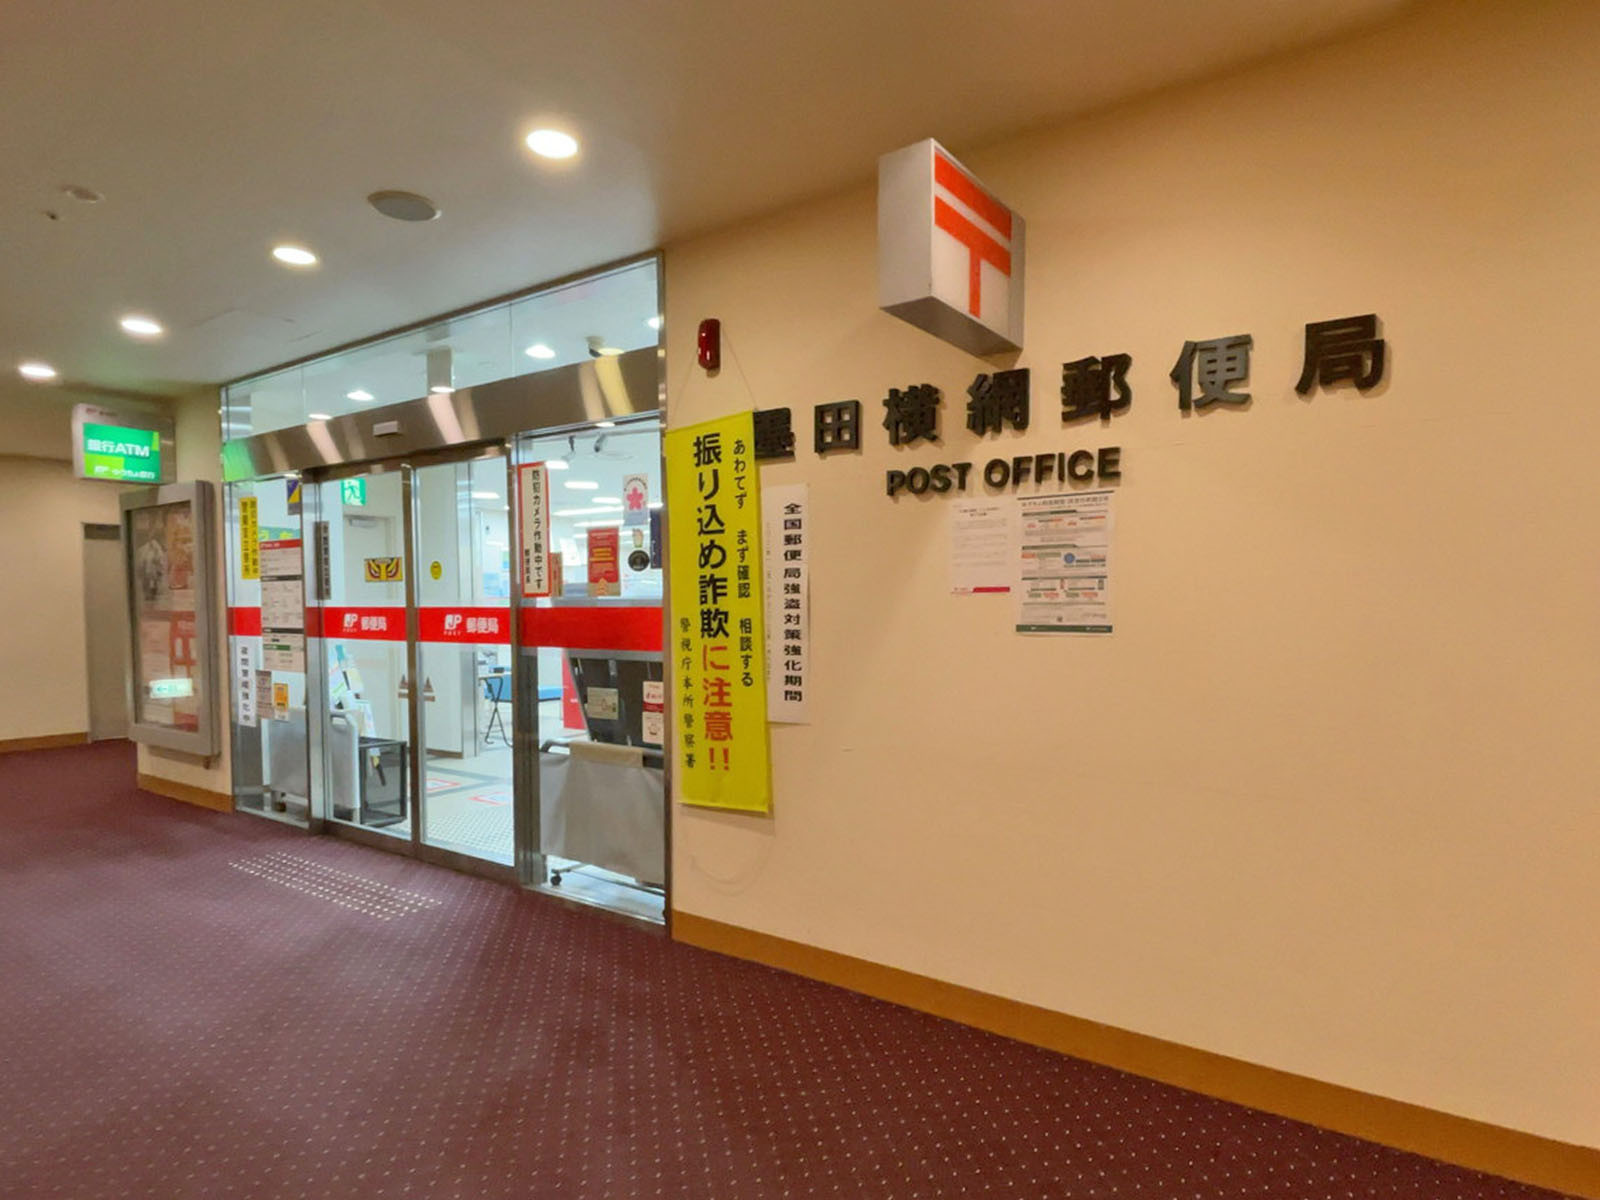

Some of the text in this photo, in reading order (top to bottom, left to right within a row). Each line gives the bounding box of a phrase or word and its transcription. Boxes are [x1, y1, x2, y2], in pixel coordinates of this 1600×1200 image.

[733, 438, 755, 687] あわてず まず確認 相談する
[886, 446, 1121, 498] POST OFFICE
[783, 502, 804, 703] 全国郵便局強盗対策強化期間
